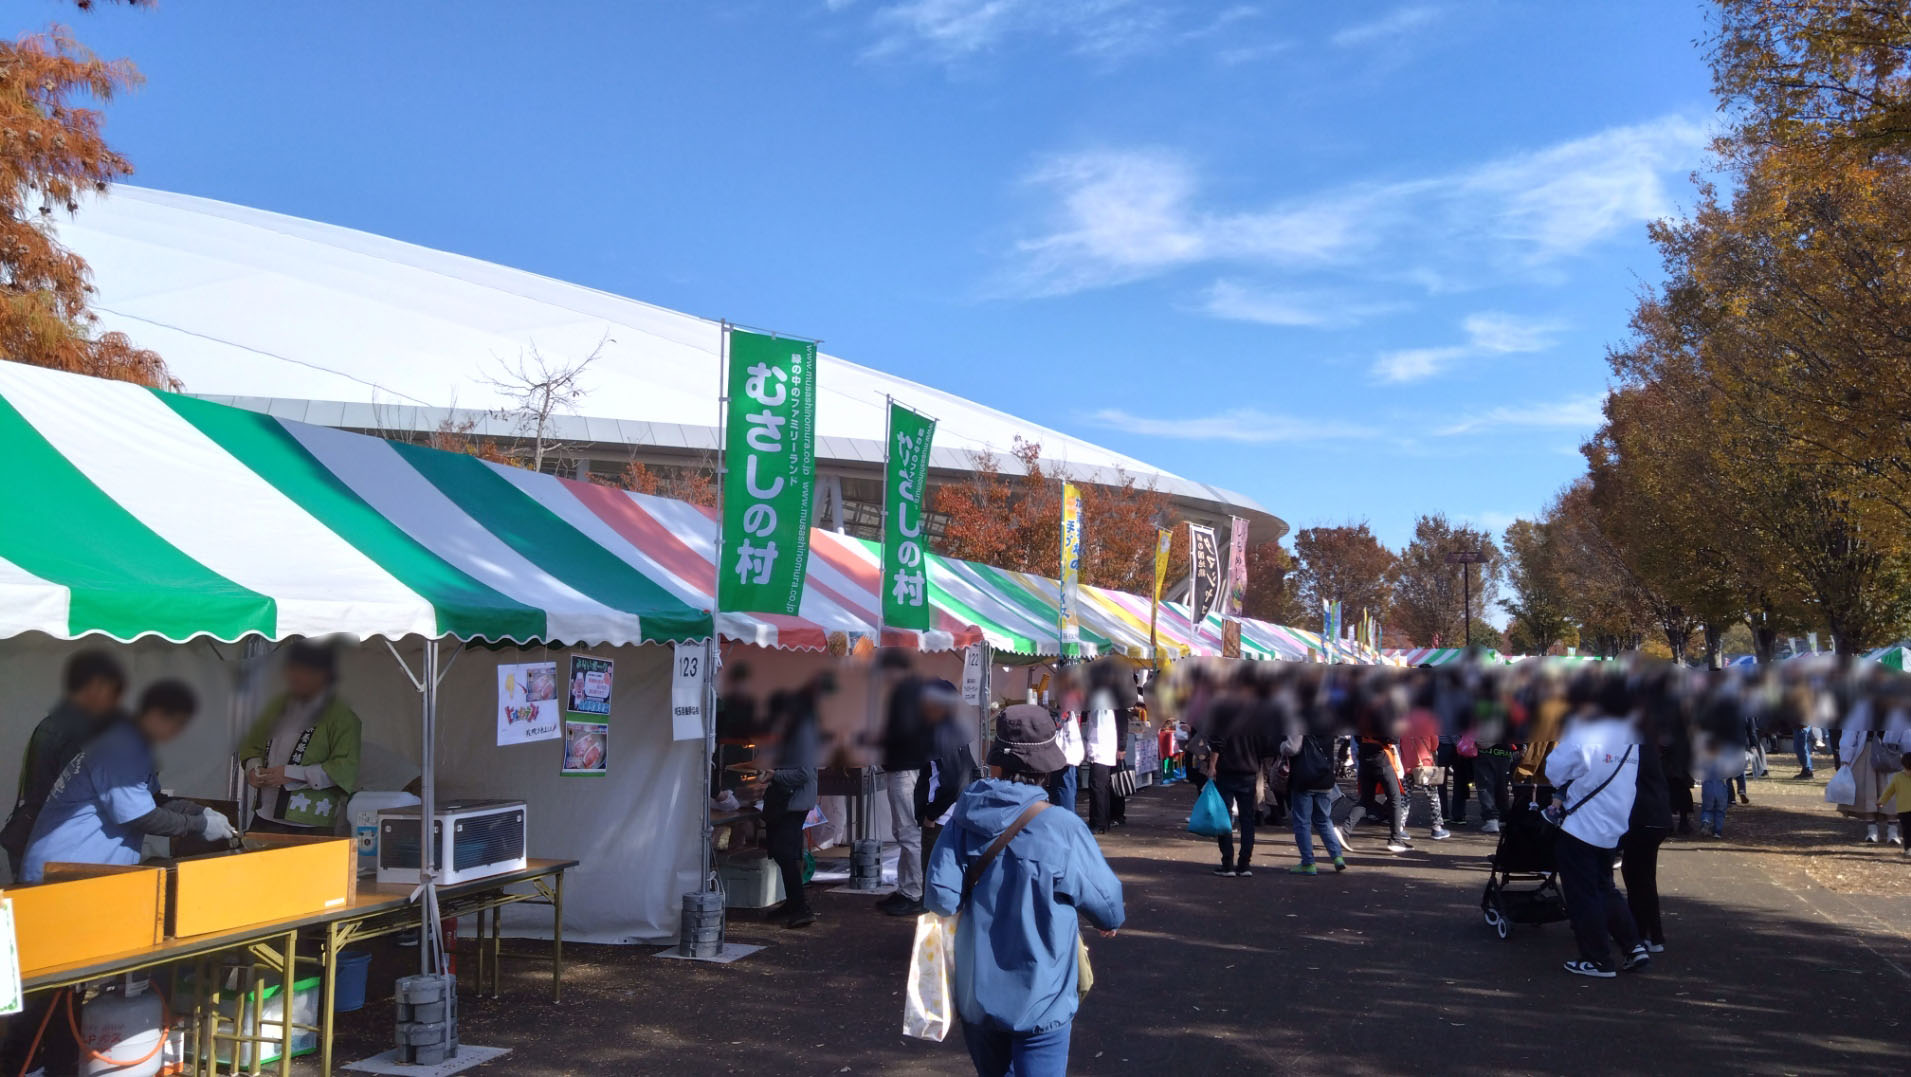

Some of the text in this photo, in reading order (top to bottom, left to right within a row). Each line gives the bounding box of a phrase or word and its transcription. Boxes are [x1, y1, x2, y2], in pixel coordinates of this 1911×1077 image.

[735, 361, 788, 585] むさしの村
[802, 344, 813, 475] www.musashinomura.co.jp
[786, 481, 809, 613] www.musashinomura.co.jp
[679, 656, 698, 677] 123
